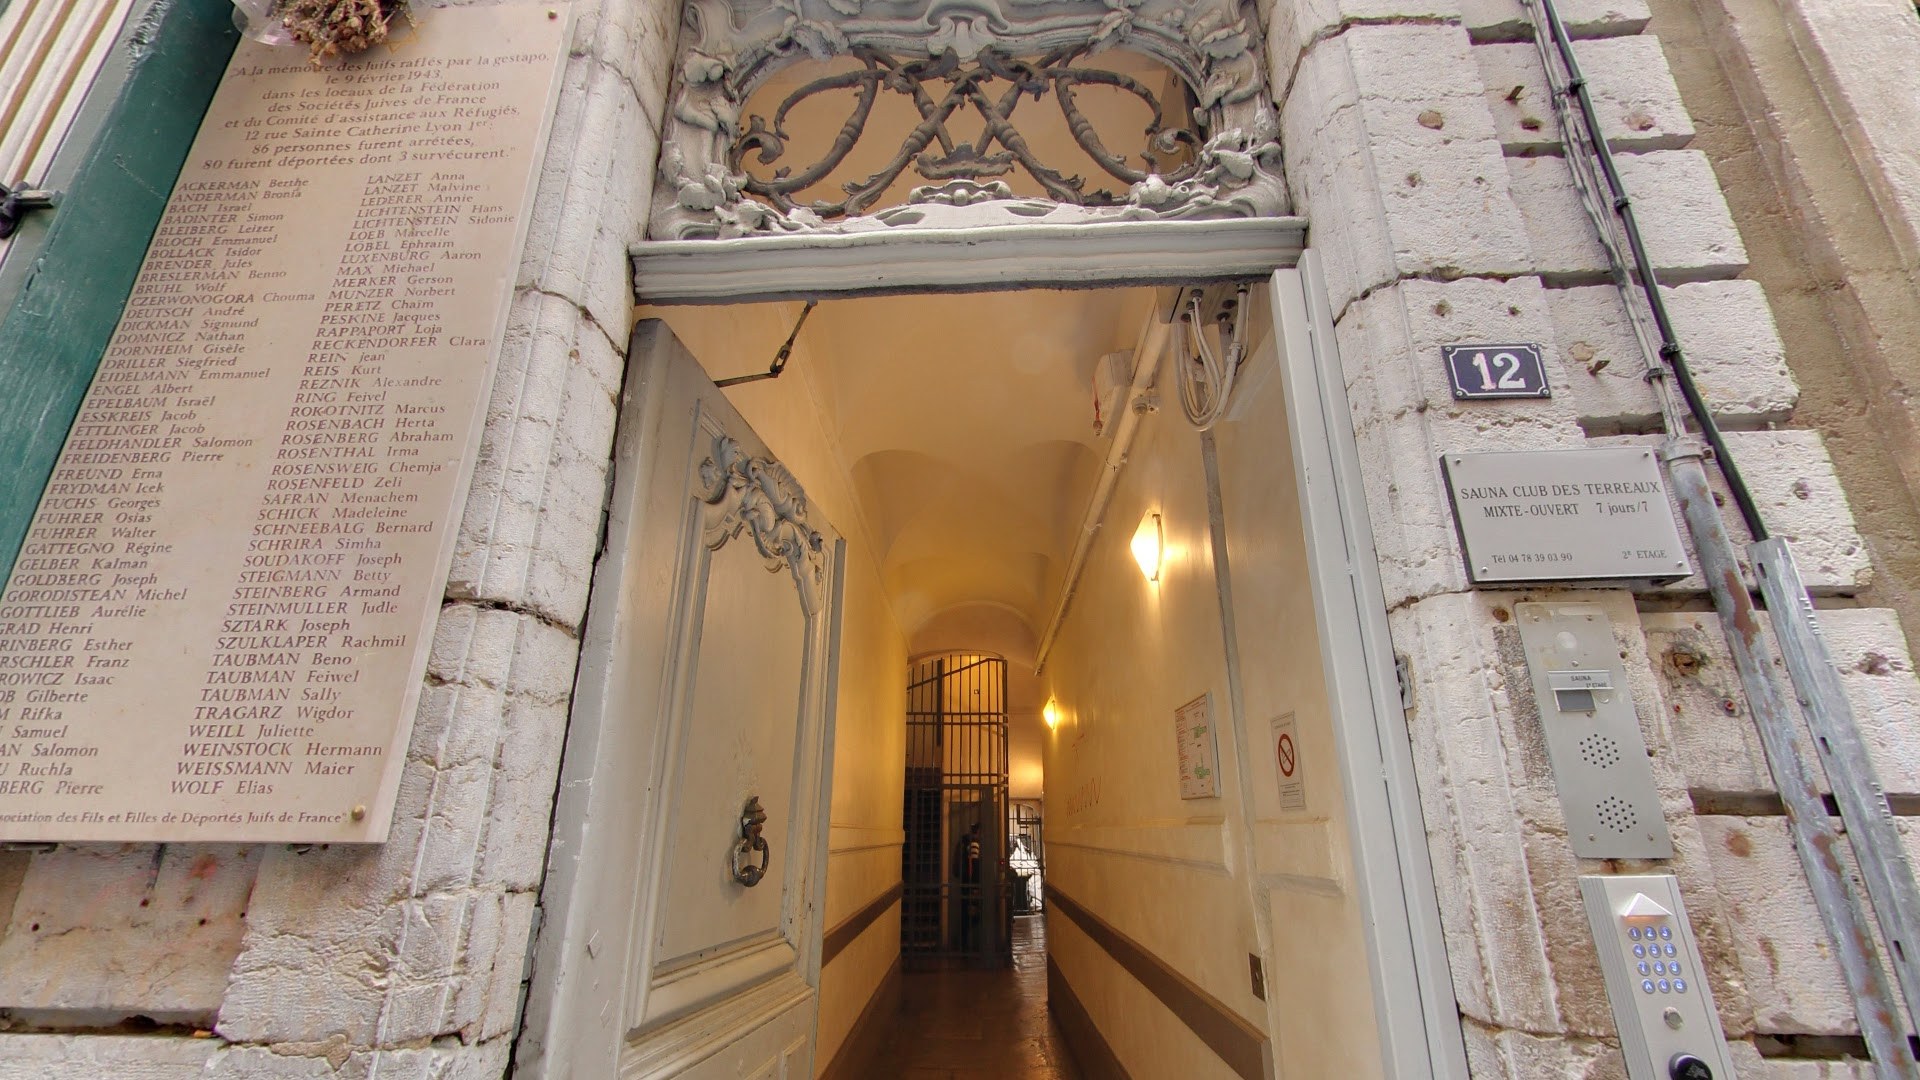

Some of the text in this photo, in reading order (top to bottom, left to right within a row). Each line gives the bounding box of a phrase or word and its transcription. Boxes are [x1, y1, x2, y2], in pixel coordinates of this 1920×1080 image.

[250, 66, 263, 75] la
[336, 62, 362, 72] des
[365, 59, 396, 72] Juifs
[398, 57, 443, 68] raflés
[446, 58, 472, 69] par
[476, 56, 489, 65] la
[325, 75, 339, 85] le
[344, 75, 354, 84] 9
[356, 73, 404, 83] février
[262, 90, 295, 100] dans
[300, 88, 320, 98] les
[325, 88, 373, 97] locaux
[379, 85, 396, 95] de
[400, 84, 413, 93] la
[268, 94, 486, 112] des Sociétés Juives de France
[224, 120, 239, 128] et
[244, 117, 262, 127] du
[266, 115, 318, 126] Comité
[418, 111, 447, 119] aux
[245, 130, 260, 141] 12
[264, 131, 288, 140] rue
[292, 128, 341, 138] Sainte
[347, 125, 420, 137] Catherine
[425, 122, 462, 132] Lyon
[252, 144, 270, 154] 86
[273, 144, 351, 156] personnes
[358, 140, 403, 150] furent
[202, 160, 223, 170] 80
[227, 159, 272, 169] furent
[278, 155, 354, 169] déportées
[359, 154, 392, 164] dont
[398, 150, 408, 162] 3
[430, 172, 465, 180] Anna
[169, 203, 252, 213] BACH Israel
[165, 213, 284, 224] BADINTER Simon
[160, 225, 275, 236] BLEIBERG Leizer
[155, 234, 278, 247] BLOCH Emmanuel
[150, 247, 262, 259] BOLLACK Isidor
[440, 251, 481, 260] Aaron
[337, 263, 435, 276] MAX Michael
[320, 312, 440, 325] PESKINE Jacques
[104, 356, 237, 370] DRILLER Siegfried
[1472, 352, 1527, 391] 12
[92, 383, 193, 396] ENGEL Albert
[87, 396, 216, 409] EPELBAUM Israël
[81, 410, 197, 422] ESSKREIS Jacob
[69, 437, 253, 450] FELDHANDLER Salomon
[281, 431, 453, 445] ROSENBERG Abraham
[63, 451, 224, 464] FREIDENBERG Pierre
[277, 446, 419, 459] ROSENTHAL Irma
[267, 476, 402, 490] ROSENFELD Zeli
[1461, 481, 1662, 500] SAUNA CLUB DES TERREAUX
[44, 497, 161, 511] FUCHS Georges
[1596, 503, 1603, 514] 7
[257, 507, 407, 520] SCHICK Madeleine
[32, 527, 156, 539] FUHRER Walter
[375, 521, 433, 533] Bernard
[26, 542, 172, 556] GATTEGNO Régine
[1637, 549, 1667, 559] ETAGE
[19, 558, 148, 570] GELBER Kalman
[1508, 554, 1518, 563] 04
[1521, 554, 1532, 562] 78
[1535, 553, 1545, 562] 39
[1548, 553, 1559, 562] 03
[1561, 552, 1572, 561] 90
[13, 573, 158, 587] GOLDBERG Joseph
[353, 569, 391, 584] Betty
[136, 588, 188, 601] Michel
[221, 618, 350, 635] SZTARK Joseph
[213, 652, 352, 667] TAUBMAN Beno
[207, 670, 359, 684] TAUBMAN Feiwel
[195, 705, 354, 723] TRAGARZ Wigdor
[190, 724, 314, 740] WEILL Juliette
[184, 742, 382, 757] WEINSTOCK Hermann
[178, 761, 355, 776] WEISSMANN Maier
[171, 780, 273, 795] WOLF Elias
[56, 811, 78, 823] des
[80, 811, 104, 823] Fils
[107, 814, 121, 823] et
[125, 811, 157, 823] Filles
[161, 812, 177, 823] de
[181, 812, 242, 826] Déportés
[246, 811, 274, 824] Juifs
[278, 811, 294, 823] de
